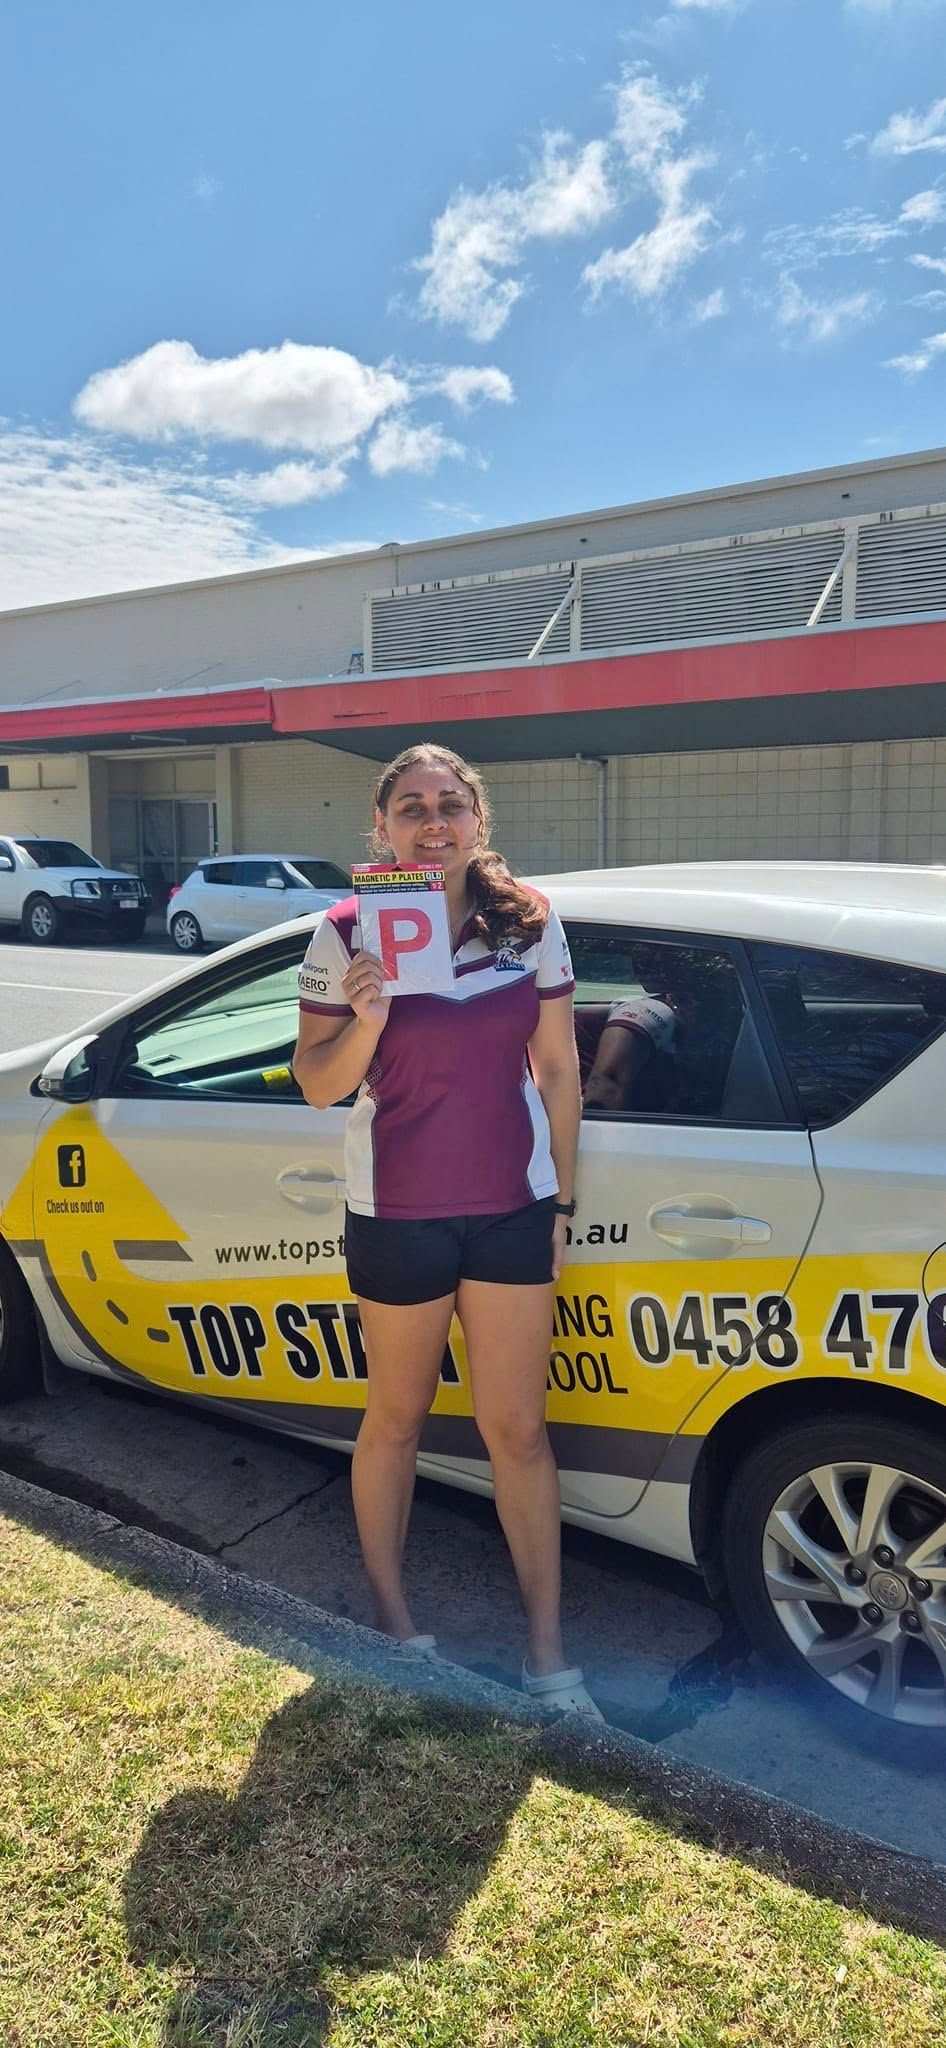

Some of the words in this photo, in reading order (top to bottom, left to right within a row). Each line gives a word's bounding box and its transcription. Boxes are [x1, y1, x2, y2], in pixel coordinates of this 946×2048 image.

[354, 874, 391, 883] MAGNETIC
[399, 872, 424, 881] PLATES
[425, 872, 442, 880] QLD
[378, 908, 432, 981] P
[46, 1199, 69, 1214] Check
[70, 1202, 80, 1214] us
[81, 1200, 94, 1214] out
[95, 1201, 105, 1214] on
[553, 1294, 614, 1338] NG
[629, 1295, 799, 1368] 0458
[168, 1303, 267, 1377] TOP
[546, 1351, 629, 1394] OOL
